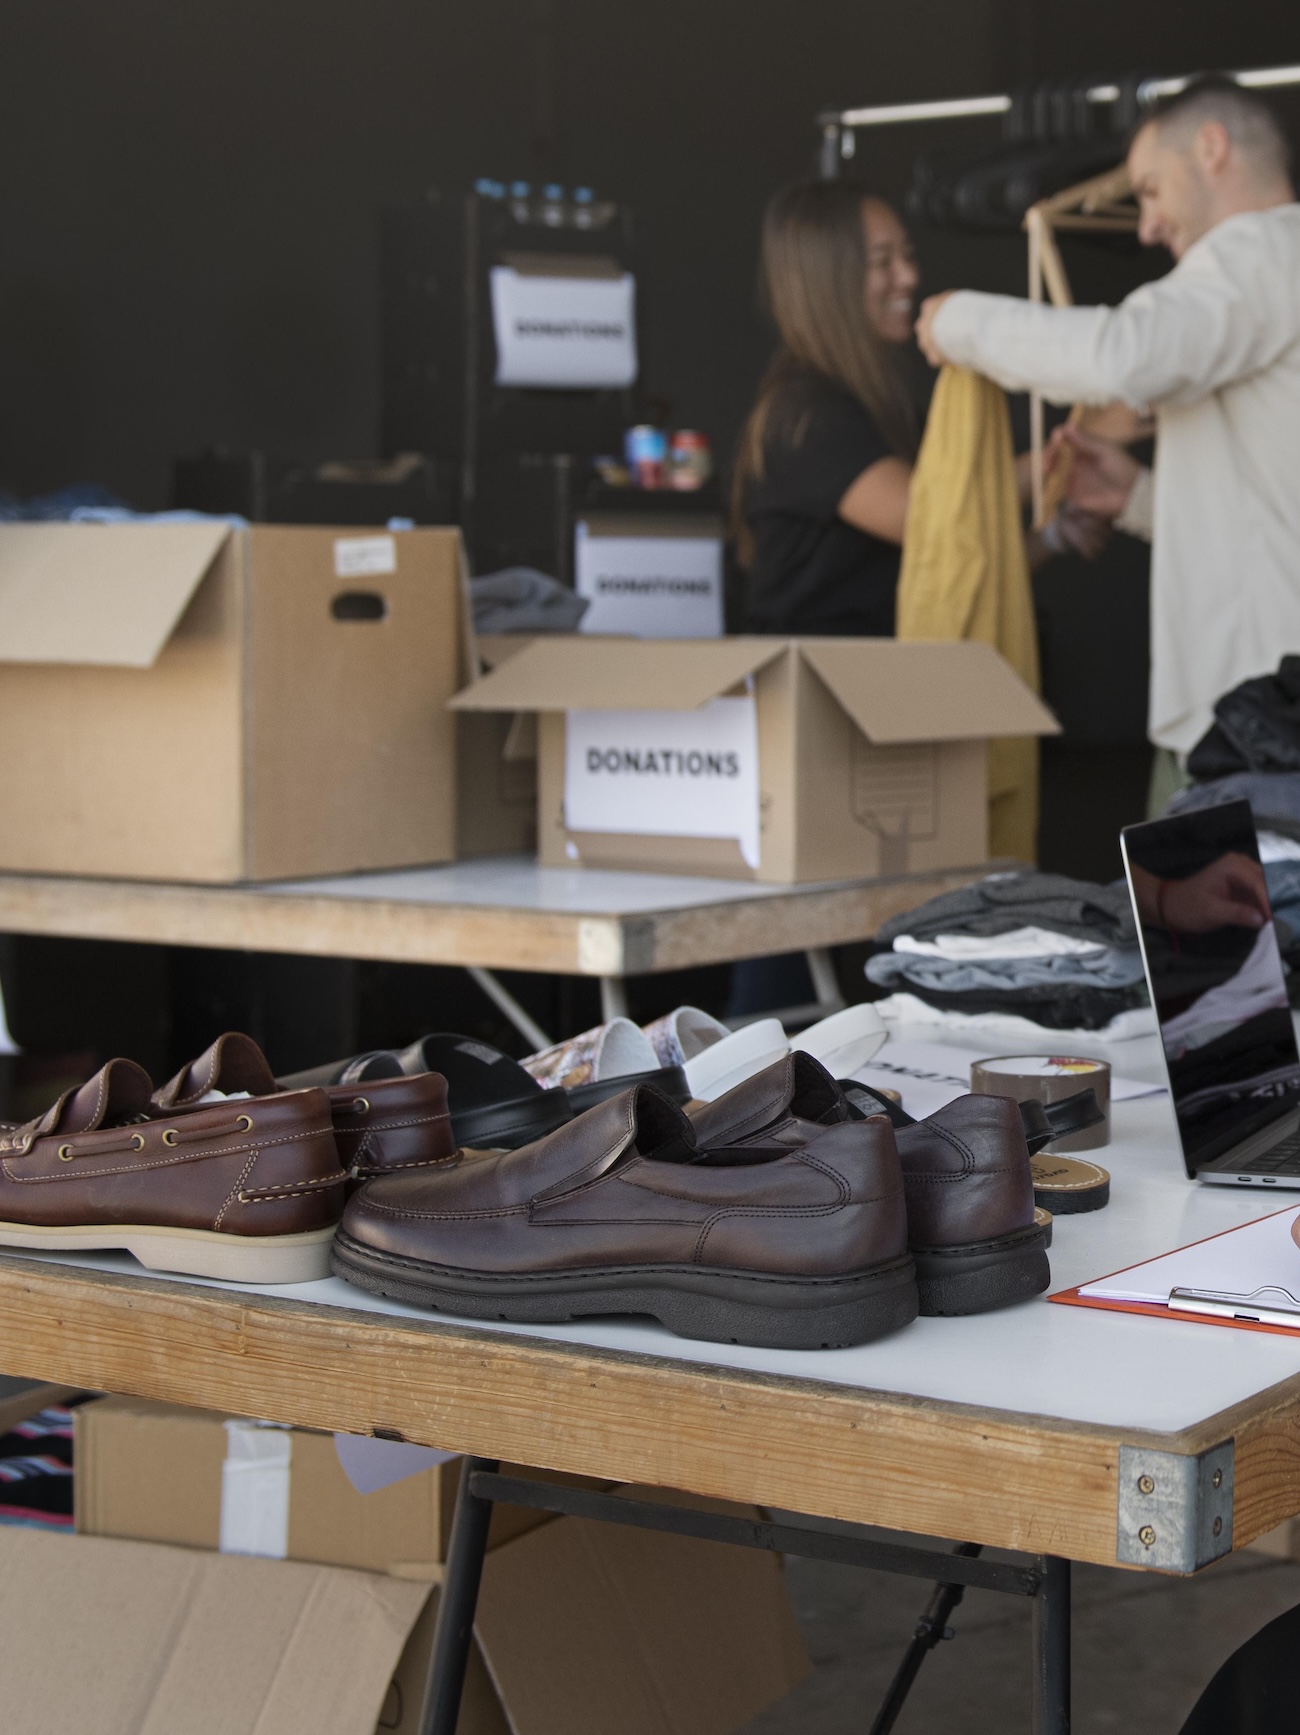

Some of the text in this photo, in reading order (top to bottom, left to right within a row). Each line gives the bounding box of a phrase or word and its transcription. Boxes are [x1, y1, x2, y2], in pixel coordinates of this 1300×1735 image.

[515, 319, 624, 341] DONATIONS
[597, 575, 711, 596] DONATIONS
[586, 749, 739, 776] DONATIONS
